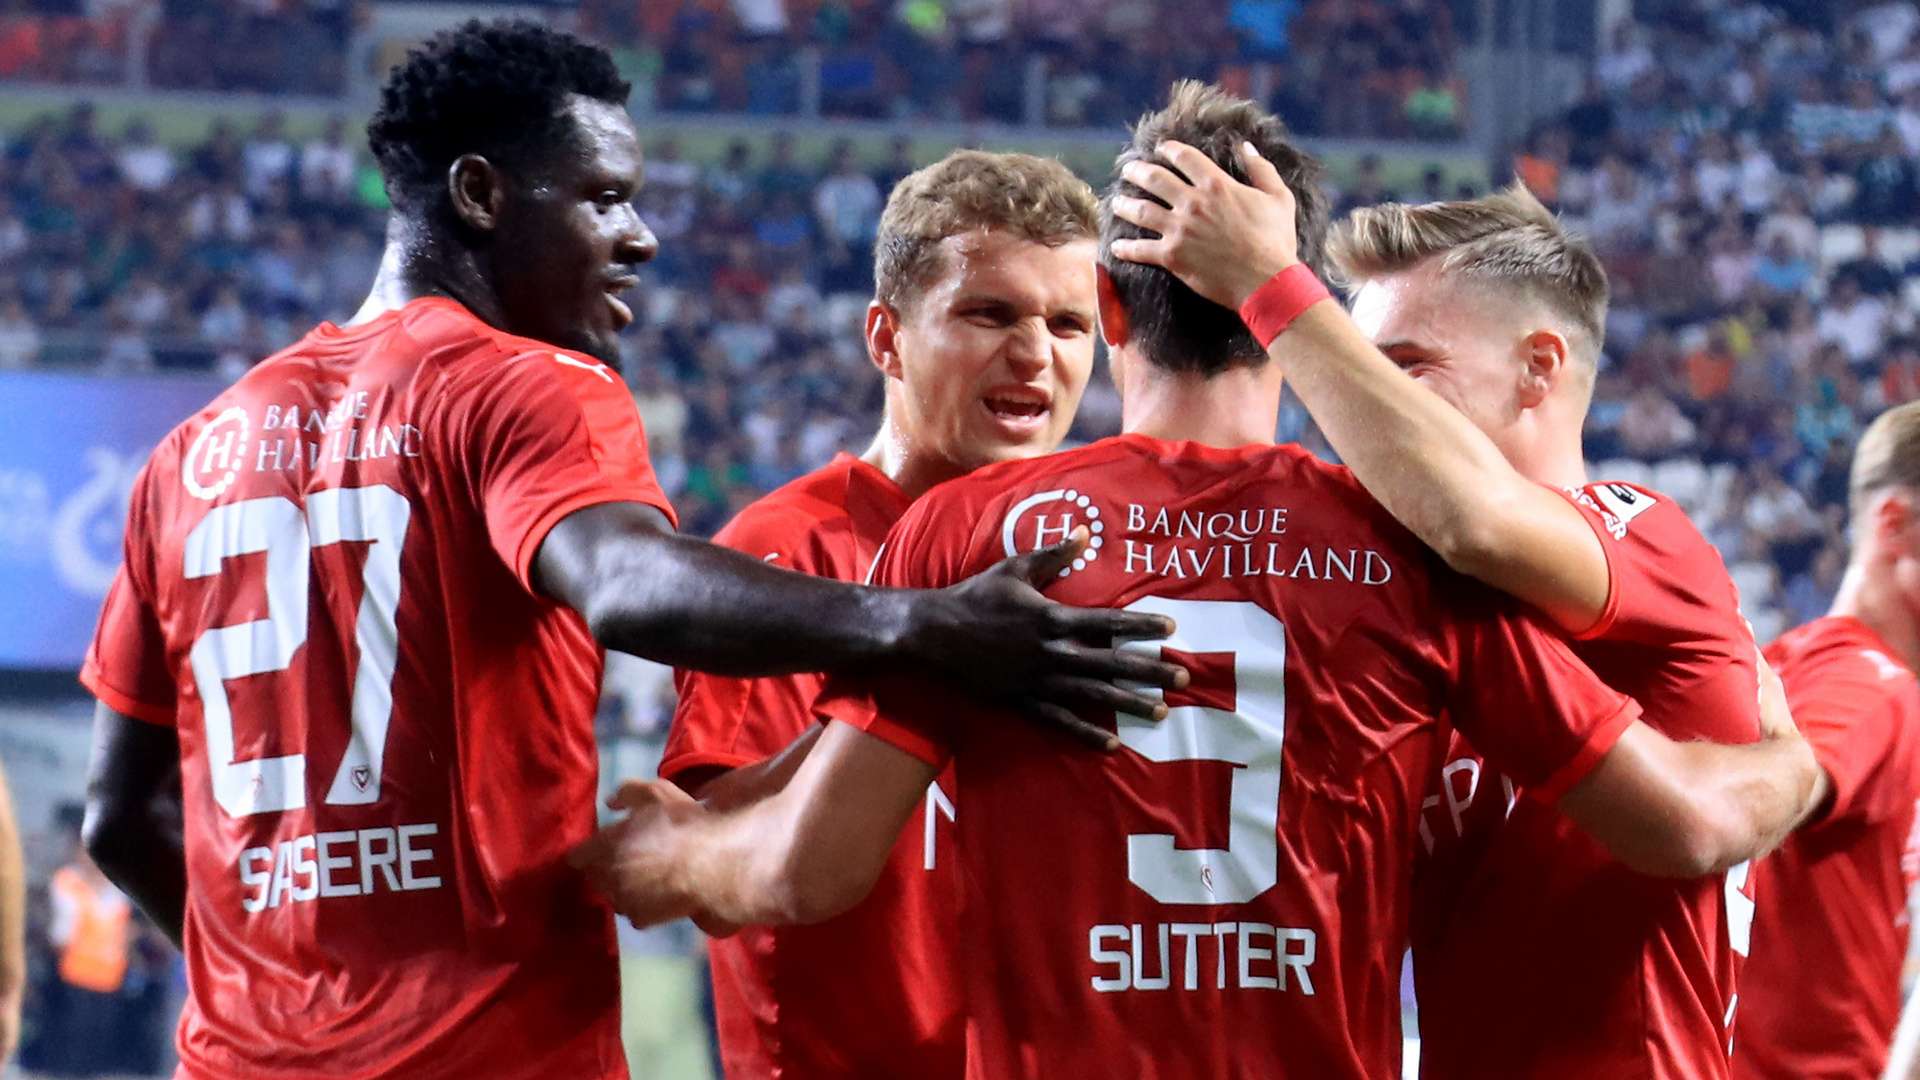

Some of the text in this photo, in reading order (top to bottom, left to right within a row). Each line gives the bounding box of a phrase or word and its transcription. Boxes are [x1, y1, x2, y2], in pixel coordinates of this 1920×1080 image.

[255, 424, 423, 472] HAVLLAND
[1127, 503, 1288, 541] BANQUE
[1124, 540, 1393, 586] HAVILLAND
[182, 484, 411, 818] 27
[1112, 595, 1287, 905] 9
[239, 823, 443, 913] SASERE
[1089, 921, 1317, 996] SUTTER
